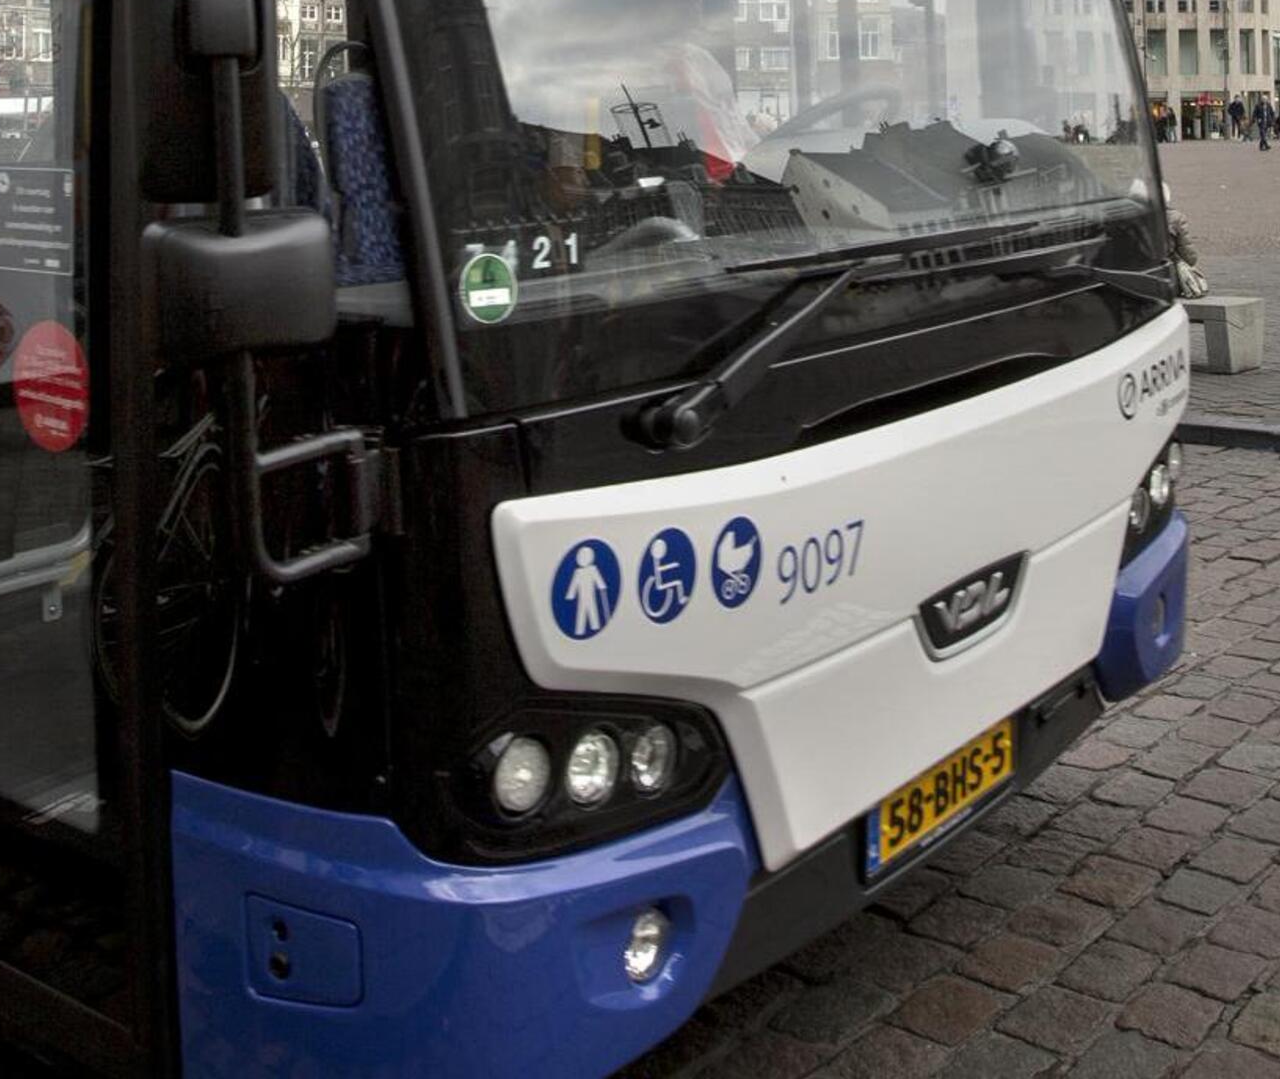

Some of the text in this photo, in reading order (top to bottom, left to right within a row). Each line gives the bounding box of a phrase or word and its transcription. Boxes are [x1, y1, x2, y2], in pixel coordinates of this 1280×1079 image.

[1139, 347, 1188, 404] ARRIVA
[776, 519, 865, 605] 9097
[933, 570, 1011, 634] VDL
[887, 730, 1006, 848] 58-BHS-5
